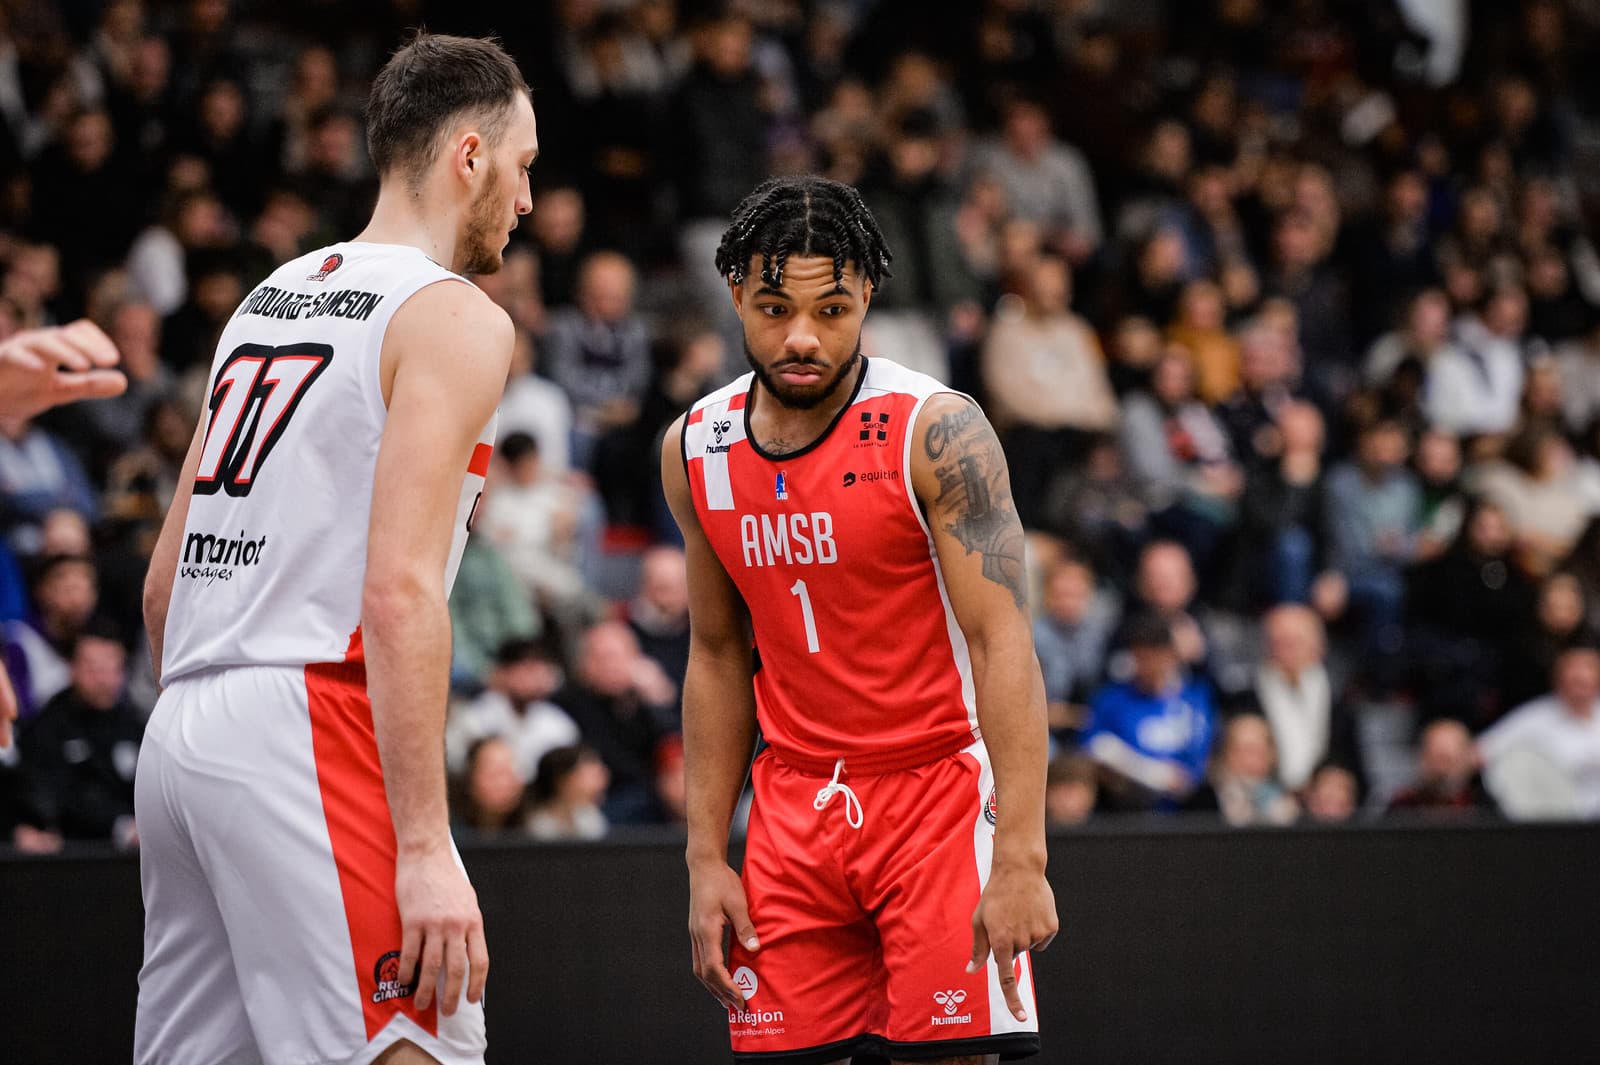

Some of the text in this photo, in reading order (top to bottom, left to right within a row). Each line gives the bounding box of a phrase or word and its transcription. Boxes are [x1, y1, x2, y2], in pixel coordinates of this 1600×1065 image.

[183, 529, 266, 567] mariot
[740, 511, 838, 567] AMSB
[790, 579, 820, 653] 1
[737, 1009, 784, 1026] Région
[931, 1013, 972, 1026] hummel
